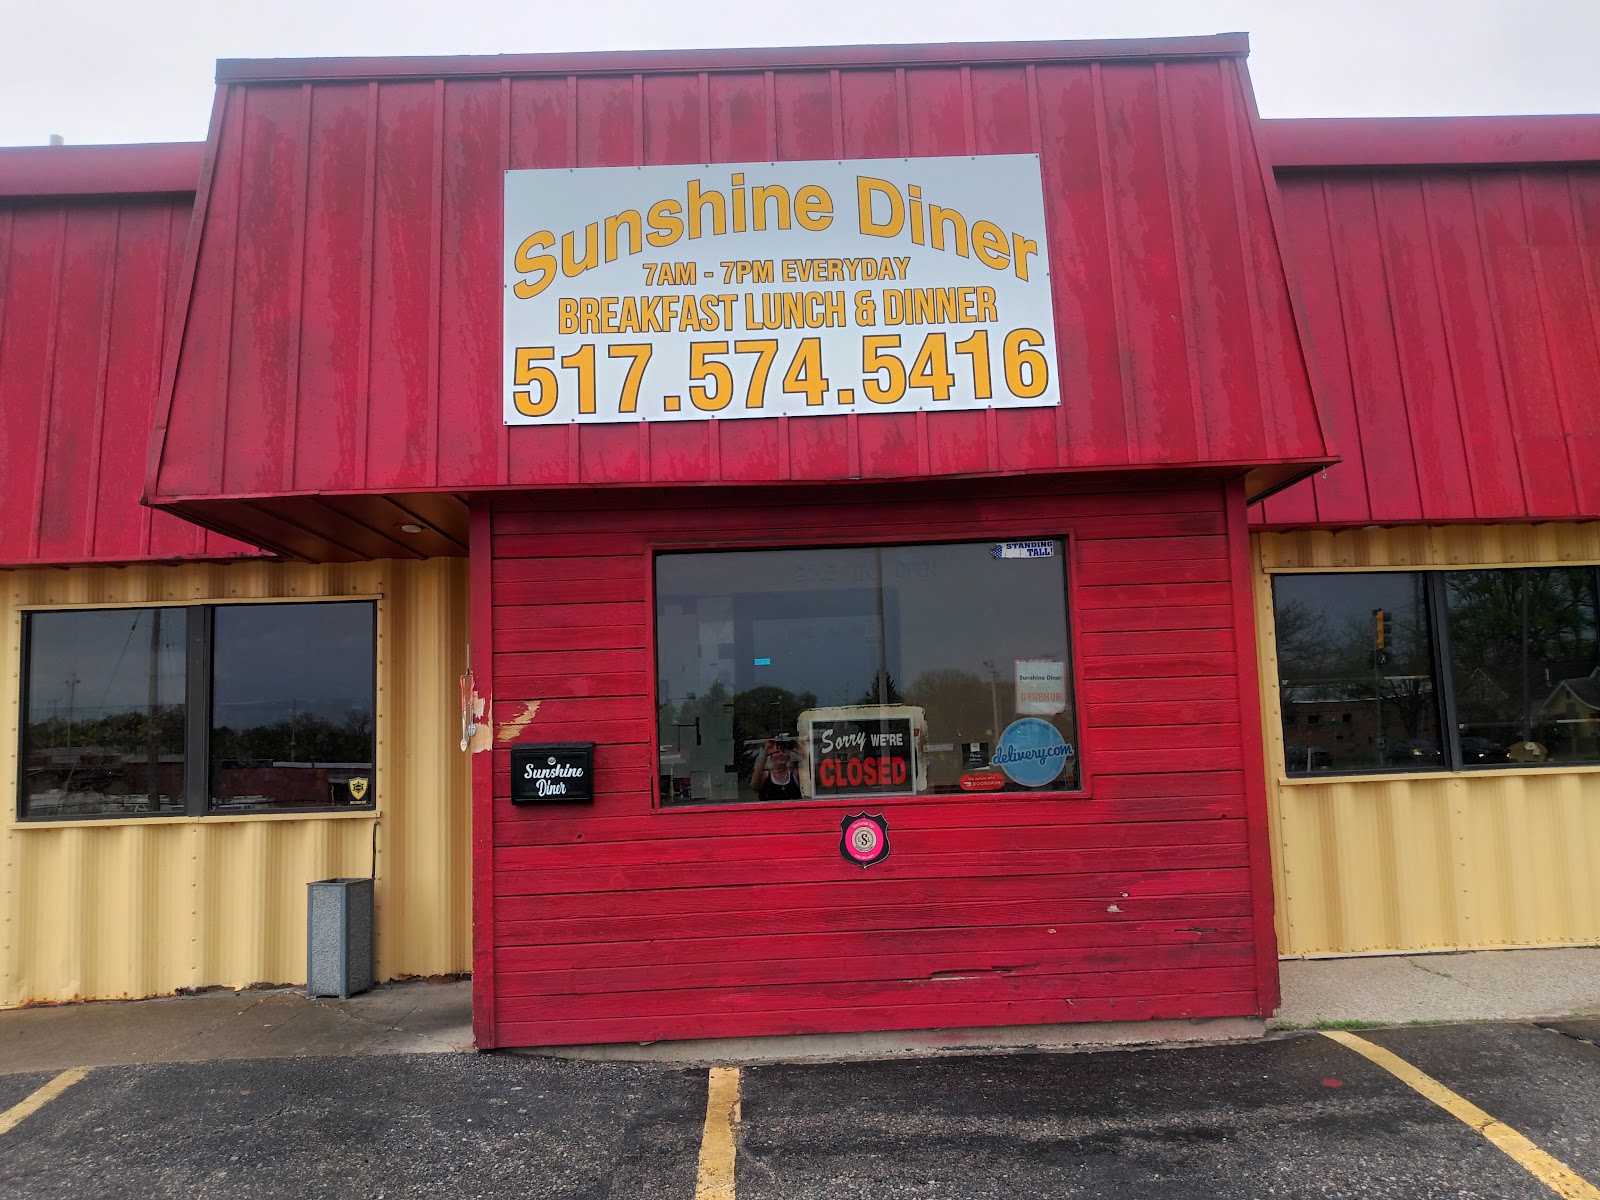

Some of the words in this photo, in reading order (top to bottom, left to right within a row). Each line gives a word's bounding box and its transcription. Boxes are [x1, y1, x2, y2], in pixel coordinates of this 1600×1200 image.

[513, 172, 834, 299] Sunshine
[856, 175, 1038, 282] Diner
[642, 262, 696, 286] 7AM
[720, 259, 774, 284] 7PM
[782, 256, 911, 282] EVERYDAY
[558, 293, 739, 335] BREAKFAST
[745, 290, 846, 331] LUNCH
[855, 290, 876, 327] &
[884, 286, 999, 326] DINNER
[513, 327, 1050, 417] 517.574.5416
[1006, 541, 1053, 550] STANDING
[1027, 547, 1053, 557] TALL!
[1020, 692, 1062, 702] GRUBHUB
[821, 729, 866, 753] Sorry
[871, 733, 903, 747] WE'RE
[993, 744, 1073, 766] delivery.com
[524, 763, 584, 779] Sunshine
[820, 756, 907, 787] CLOSED
[536, 779, 566, 797] Diner
